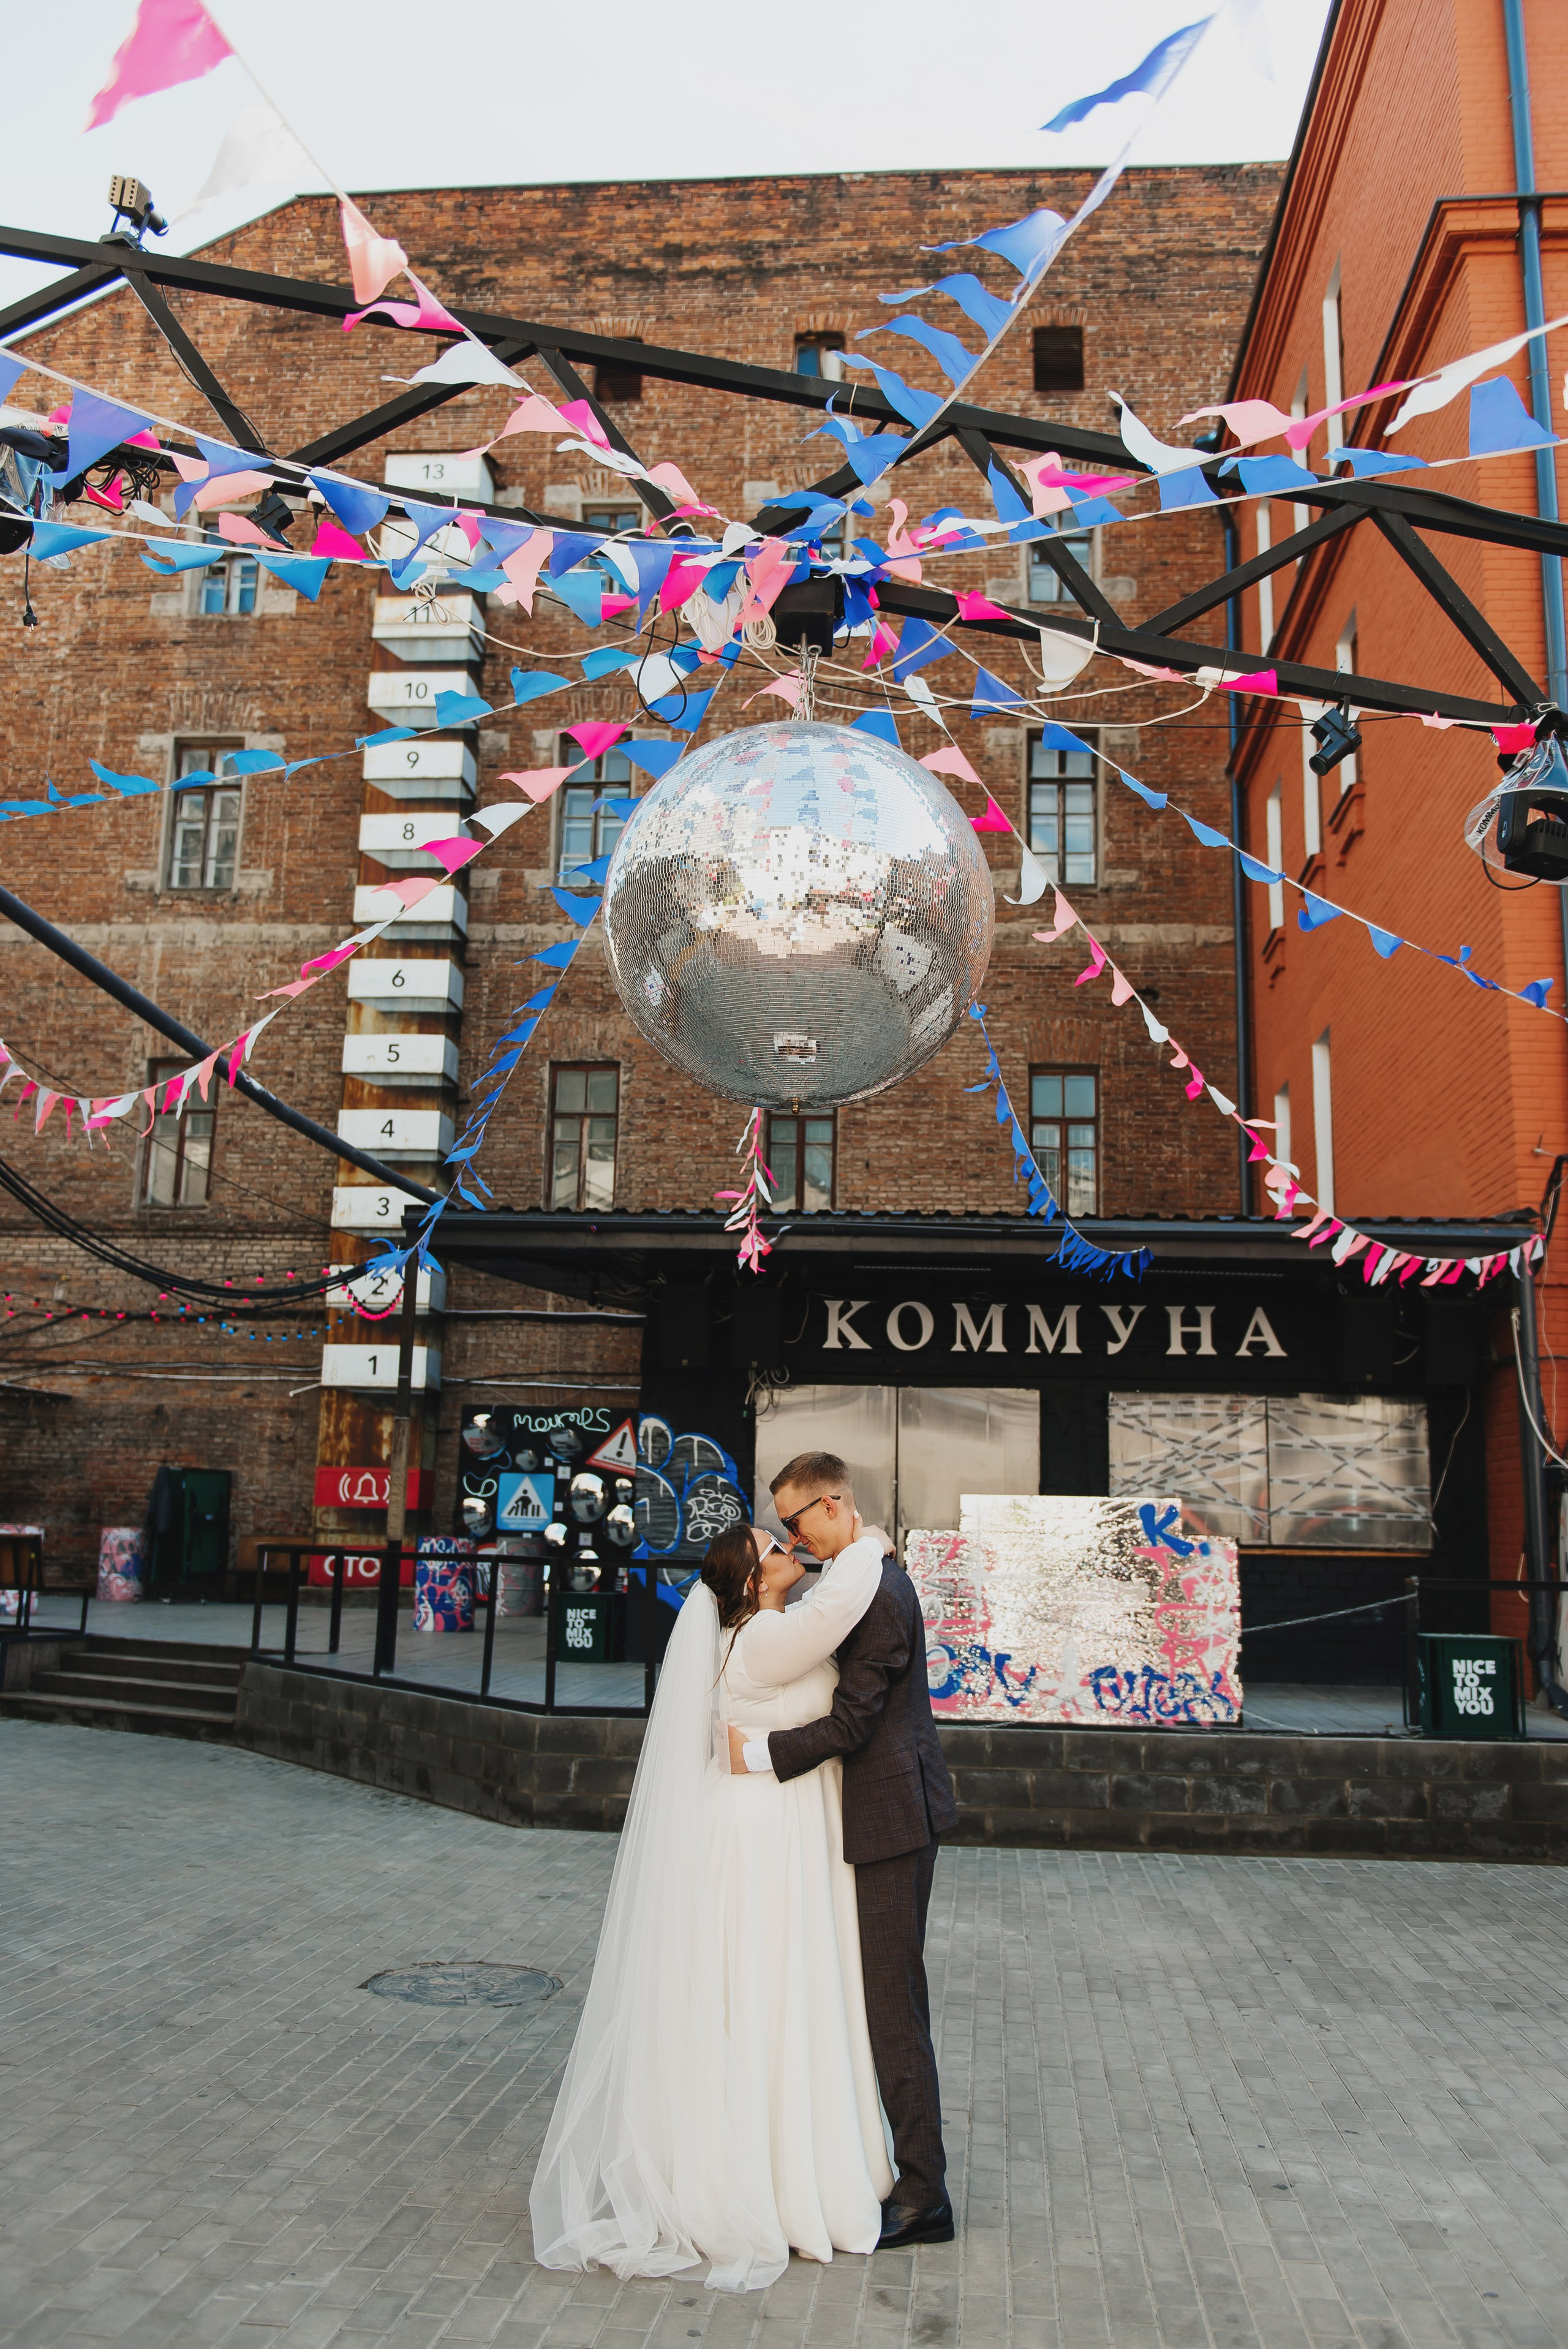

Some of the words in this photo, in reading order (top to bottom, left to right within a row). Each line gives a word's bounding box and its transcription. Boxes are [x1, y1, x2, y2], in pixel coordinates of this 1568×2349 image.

[423, 463, 444, 480] 13
[410, 605, 430, 624] 11
[405, 683, 428, 699] 10
[407, 752, 419, 769] 9
[403, 823, 415, 840] 8
[392, 970, 405, 987] 6
[387, 1044, 400, 1062] 5
[380, 1120, 394, 1137] 4
[375, 1197, 390, 1217] 3
[822, 1300, 1288, 1357] КОММУНА
[368, 1355, 378, 1374] 1
[566, 1608, 597, 1619] NICE
[567, 1618, 585, 1628] TO
[566, 1627, 592, 1638] MIX
[566, 1638, 593, 1648] YOU
[1452, 1659, 1496, 1675] NICE
[1453, 1673, 1480, 1687] TO
[1453, 1686, 1493, 1701] MIX
[1455, 1700, 1494, 1715] YOU
